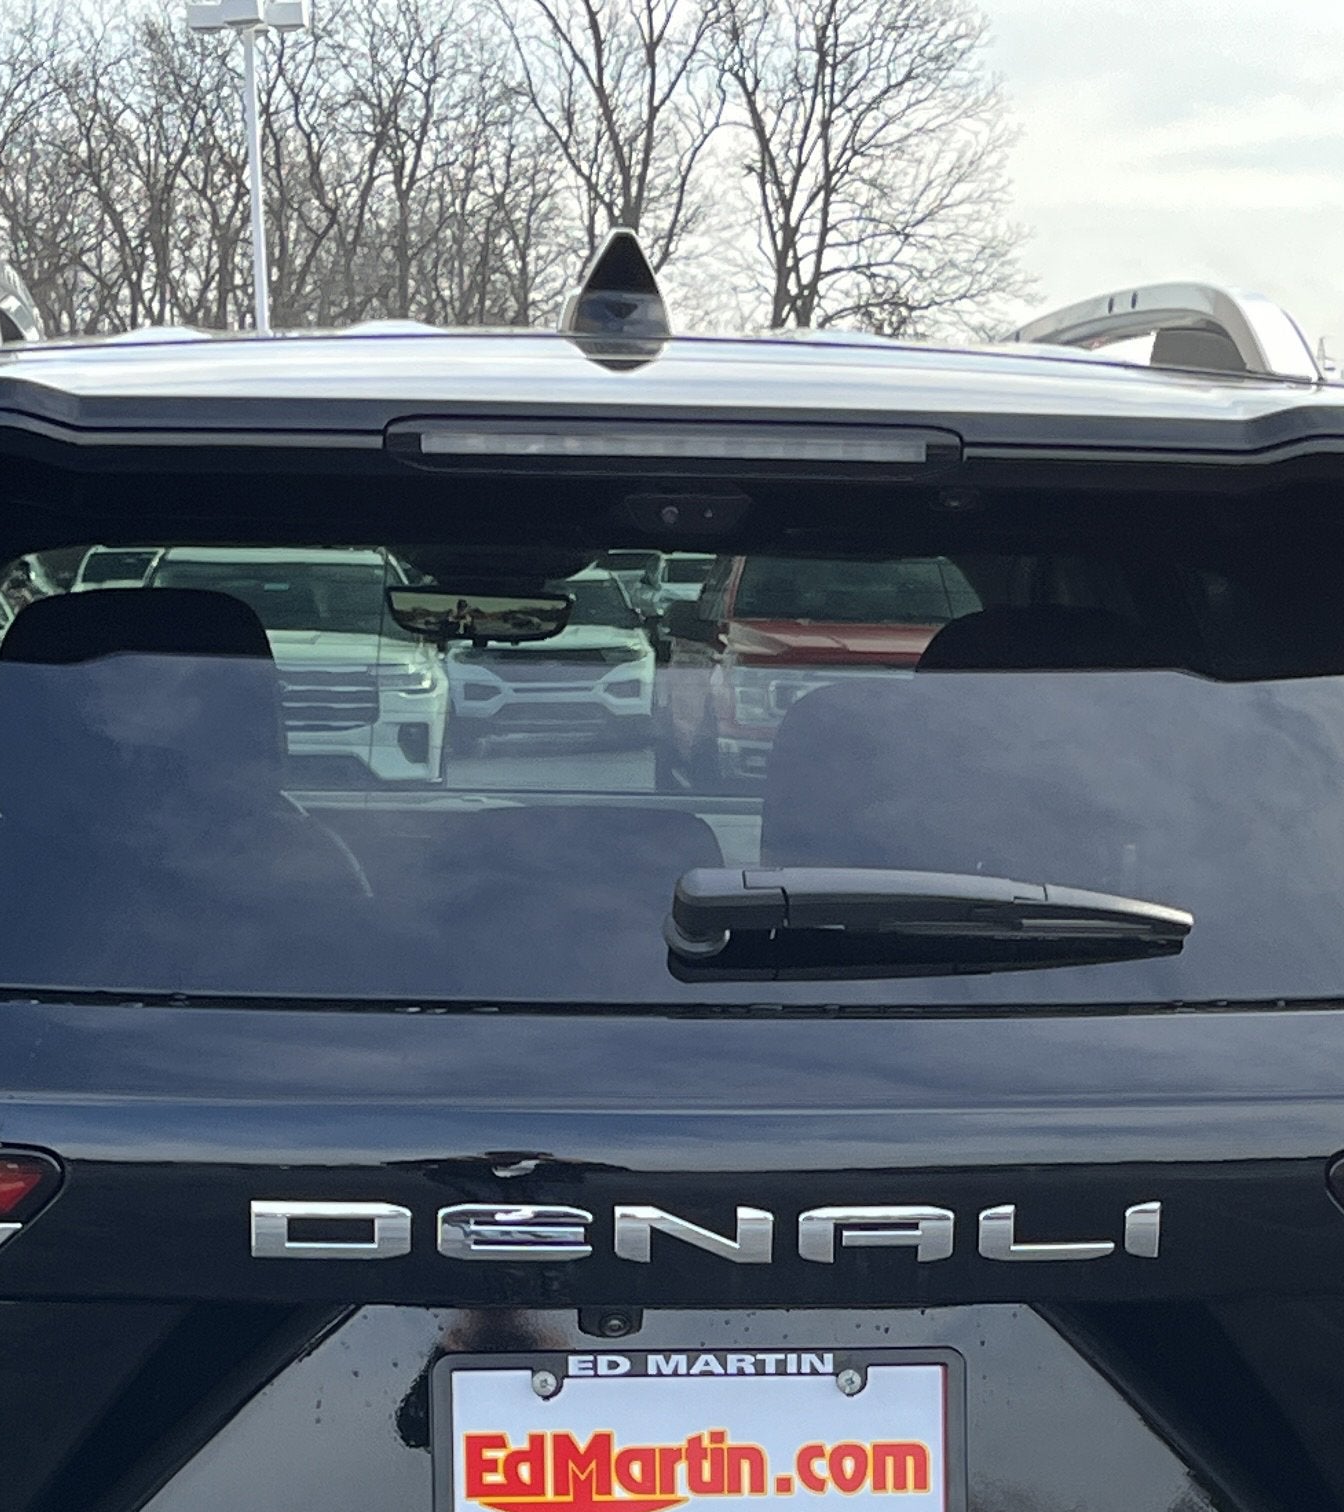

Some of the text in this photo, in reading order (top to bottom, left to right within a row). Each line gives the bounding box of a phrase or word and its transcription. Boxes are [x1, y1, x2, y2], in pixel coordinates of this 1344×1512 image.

[250, 1200, 1161, 1264] DENALI
[567, 1353, 836, 1377] ED MARTIN
[463, 1429, 931, 1500] EdMartin.com
